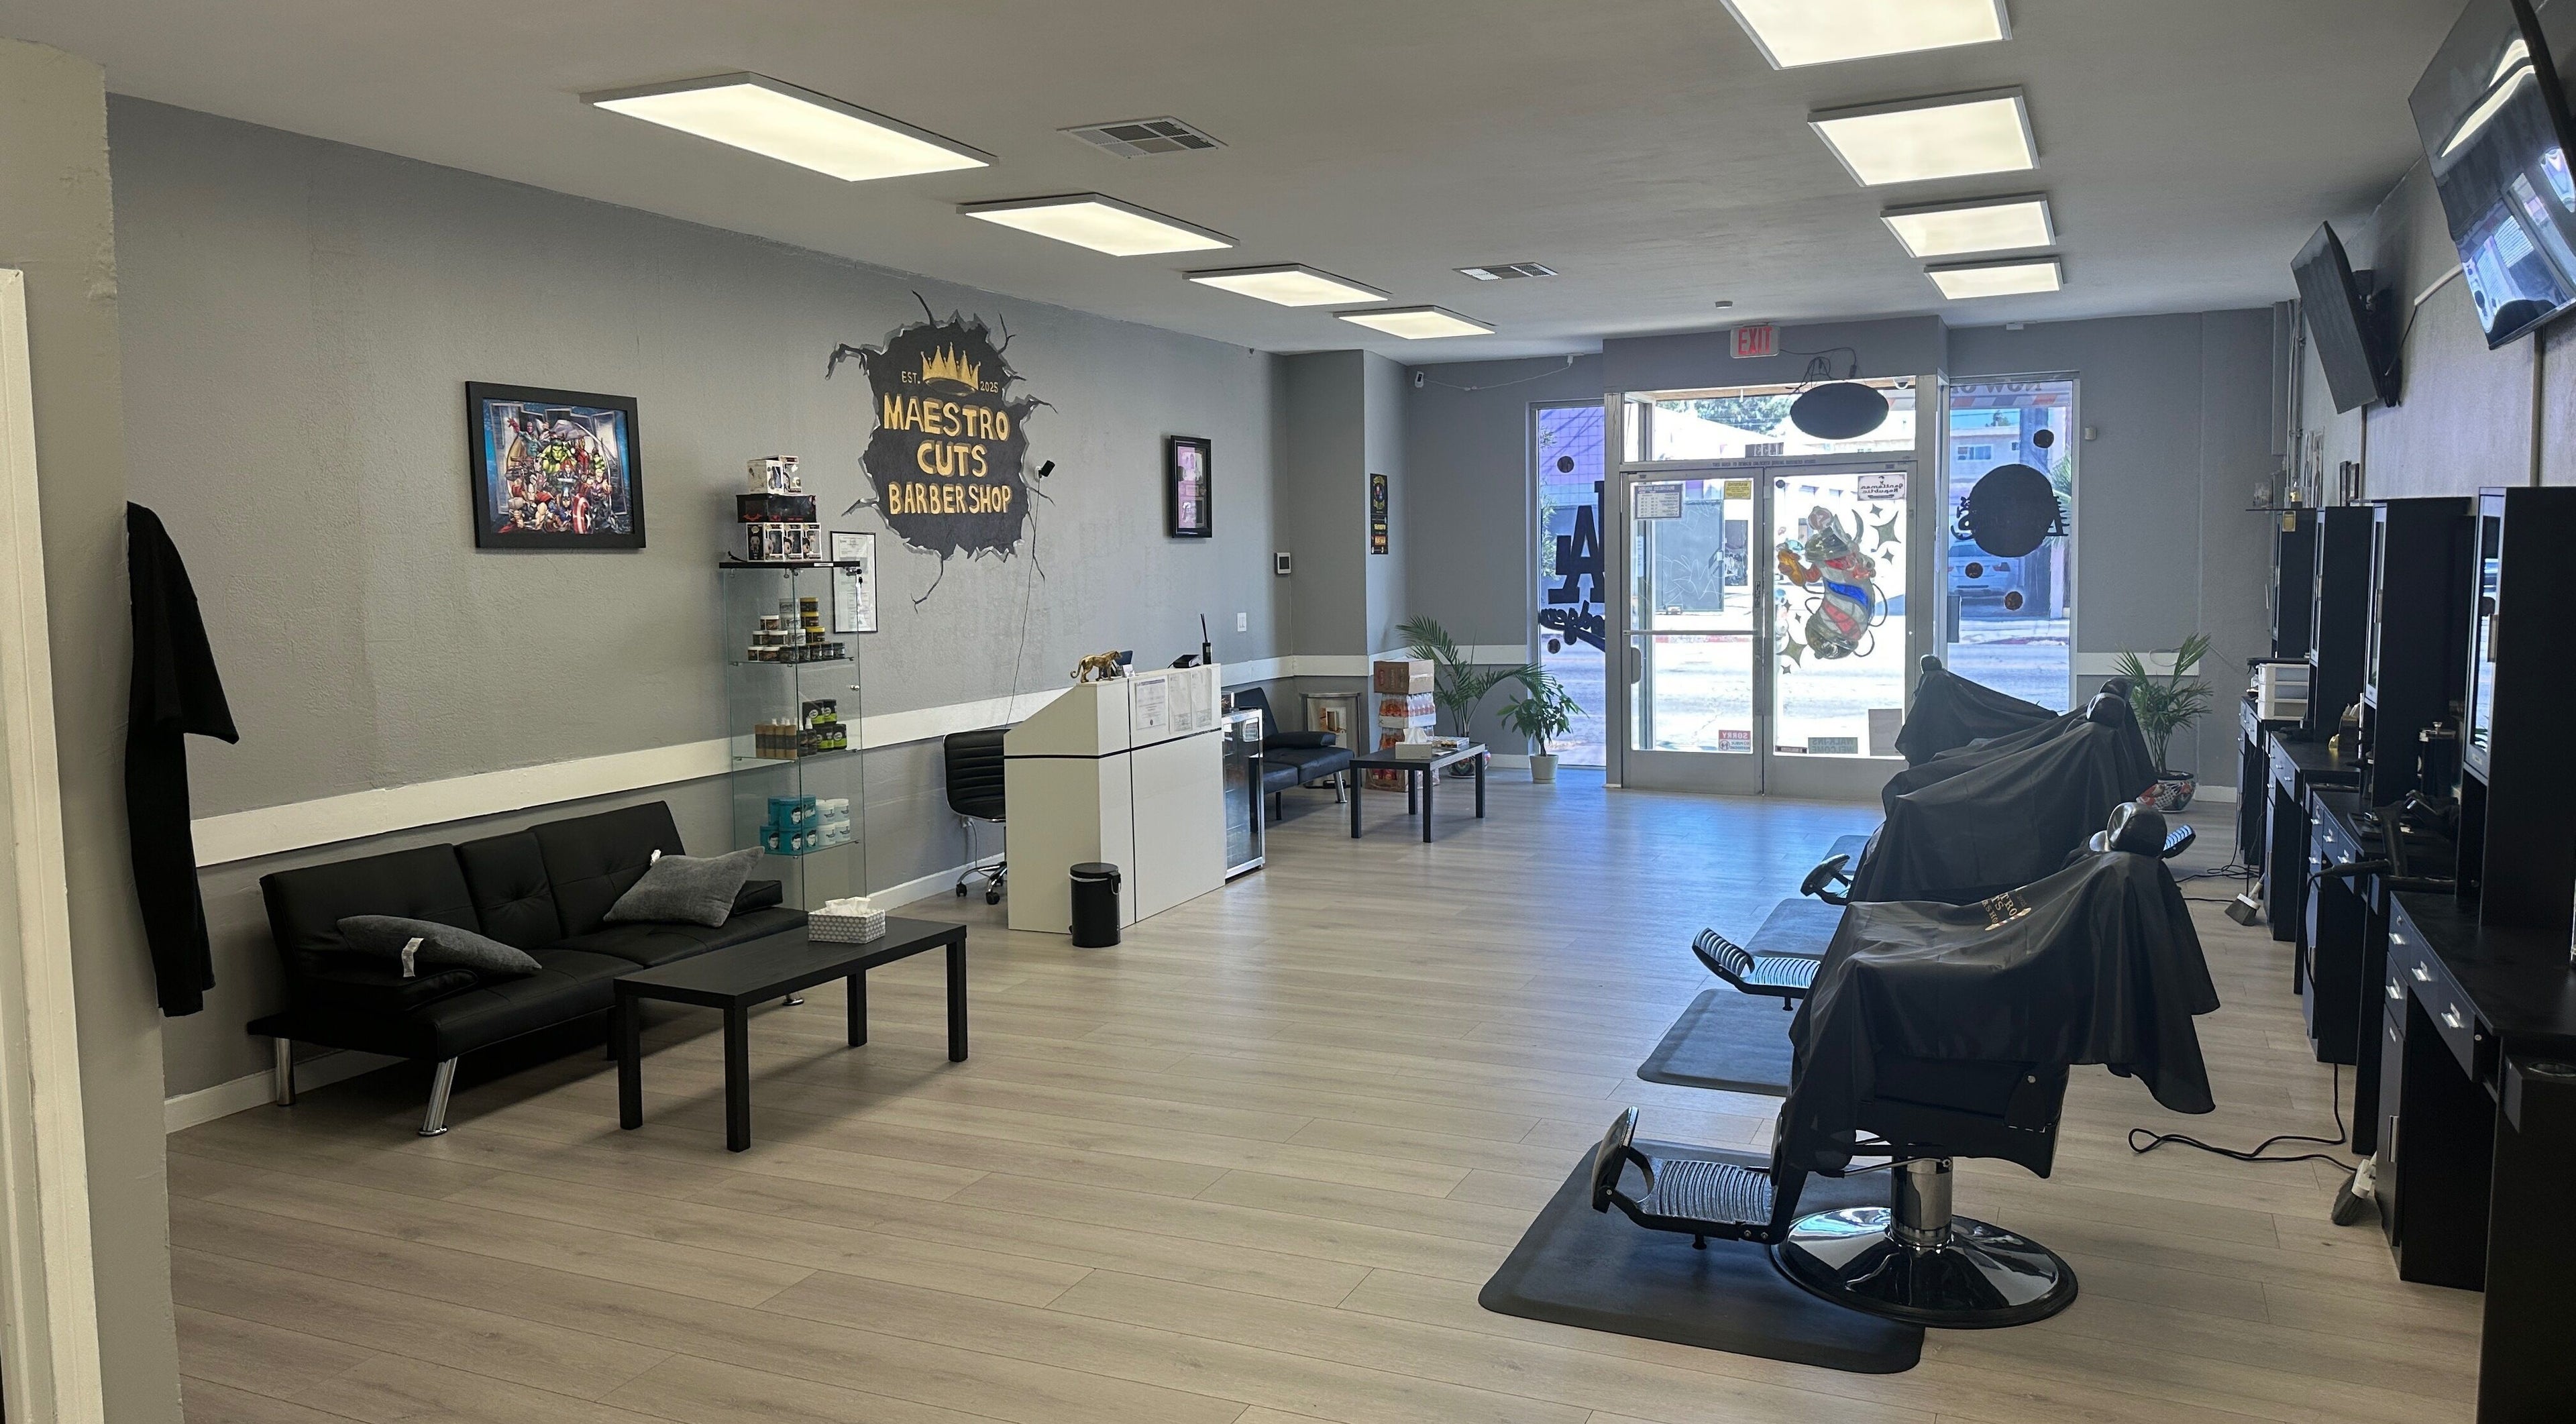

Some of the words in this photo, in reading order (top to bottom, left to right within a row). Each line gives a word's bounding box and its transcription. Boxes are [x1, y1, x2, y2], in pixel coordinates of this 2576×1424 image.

[1738, 326, 1772, 355] EXIT
[901, 370, 920, 385] EST.
[980, 380, 999, 394] 2025
[883, 392, 1010, 442] MAESTRO
[916, 439, 988, 478] CUTS
